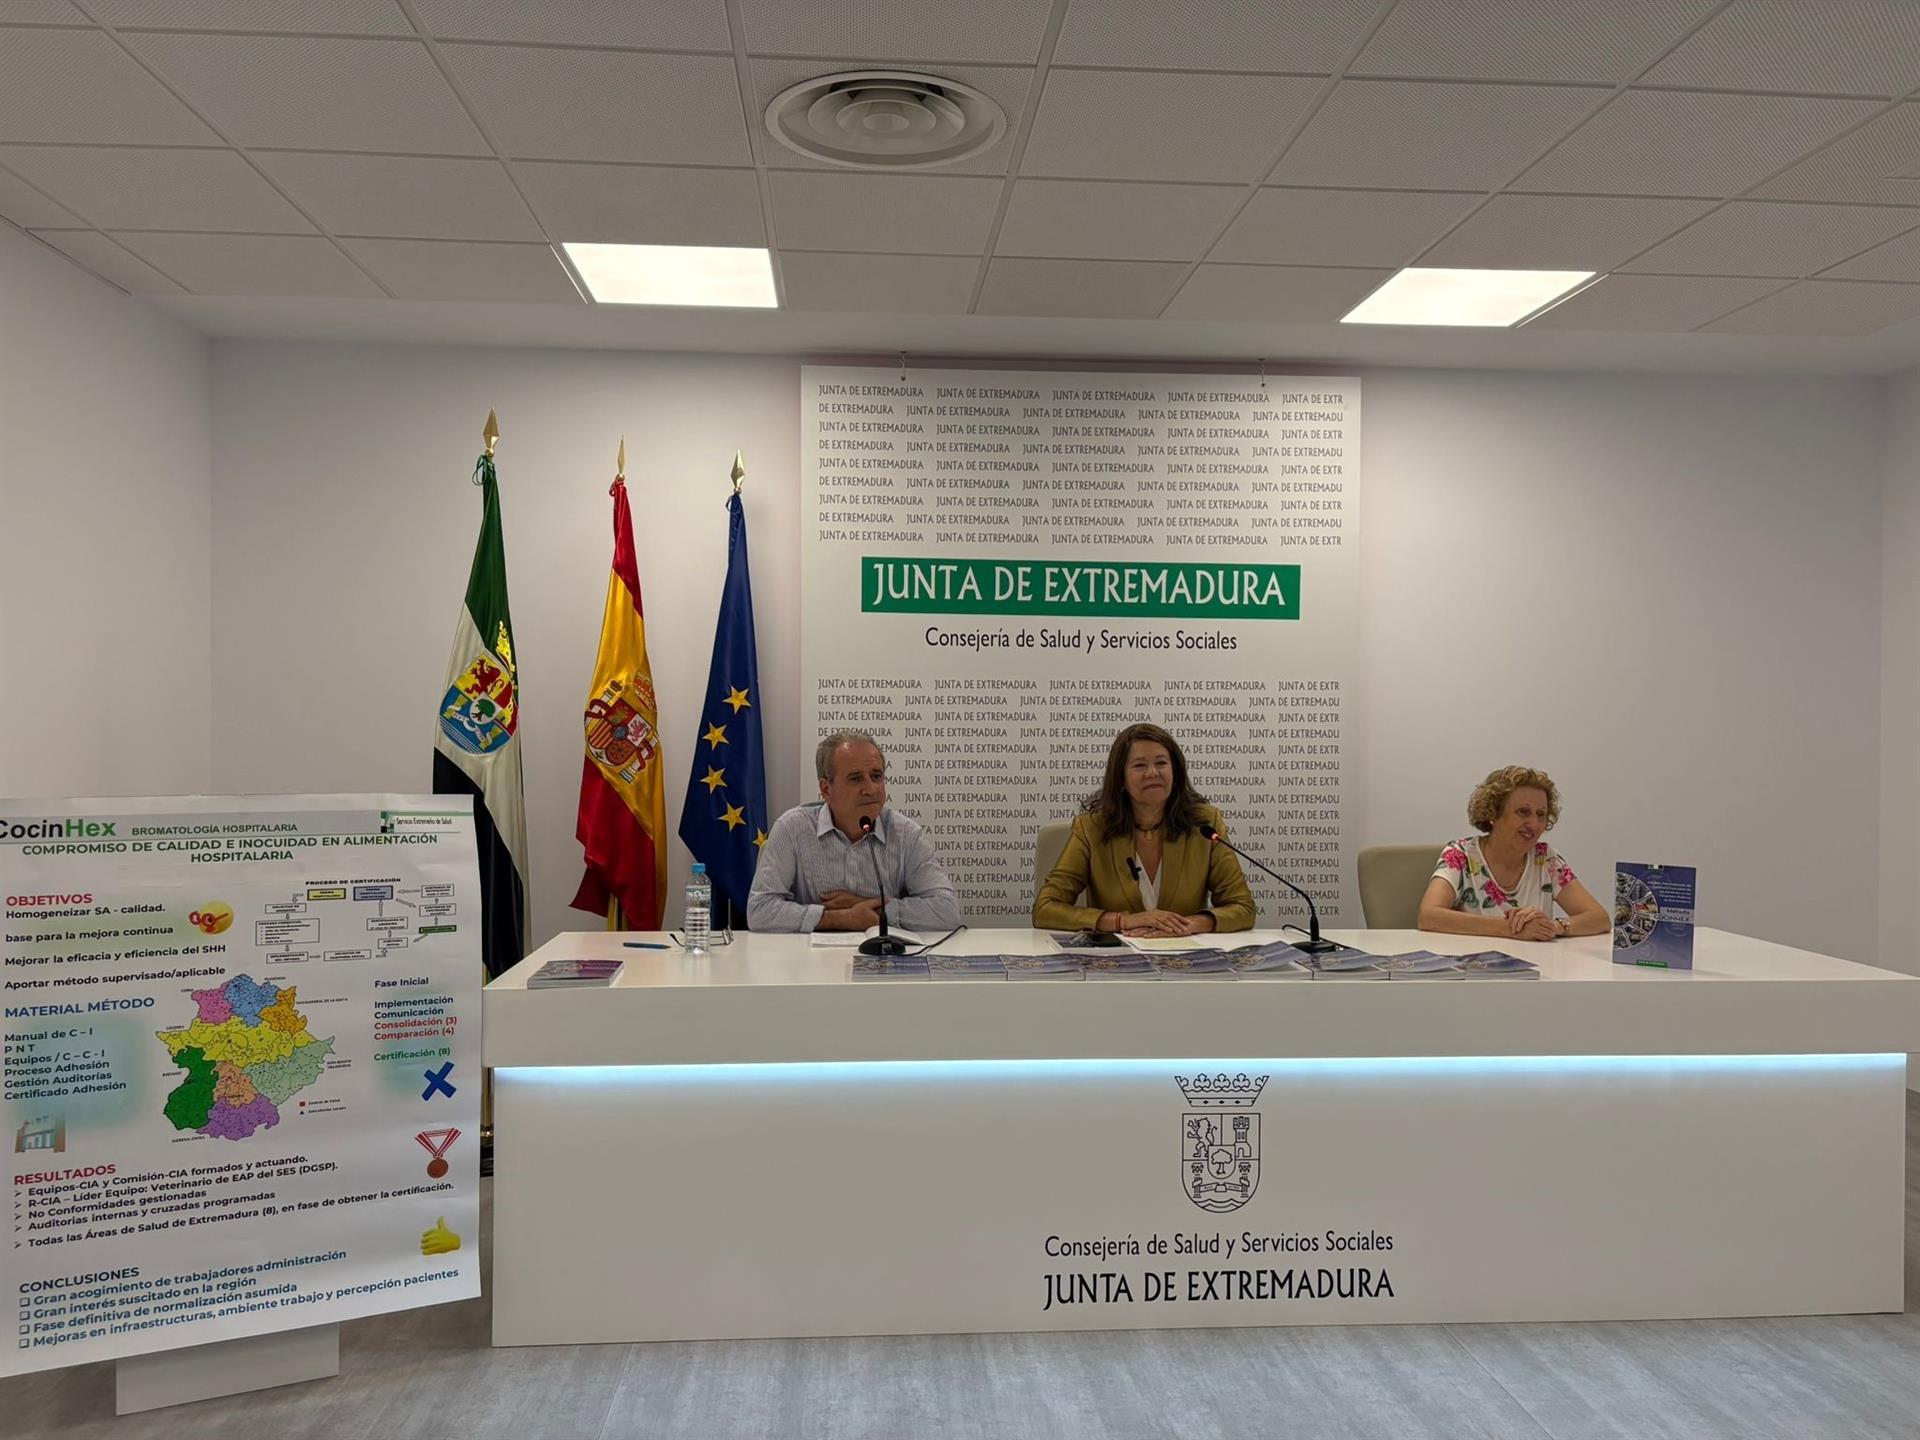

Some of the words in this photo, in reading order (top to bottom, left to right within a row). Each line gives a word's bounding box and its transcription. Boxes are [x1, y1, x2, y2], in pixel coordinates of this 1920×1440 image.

[819, 384, 847, 395] JUNTA
[849, 385, 859, 395] DE
[862, 384, 924, 397] EXTREMADURA
[1282, 391, 1310, 405] JUNTA
[1311, 392, 1323, 403] DE
[1324, 394, 1343, 403] EXTR
[873, 564, 982, 605] JUNTA
[995, 567, 1032, 601] DE
[1044, 569, 1287, 606] EXTREMADURA
[926, 627, 1009, 652] Consejería
[1016, 629, 1034, 647] de
[1041, 629, 1080, 648] Salud
[1087, 636, 1094, 653] y
[1101, 630, 1169, 648] Servicios
[1176, 630, 1236, 649] Sociales
[1164, 681, 1191, 691] JUNTA
[1194, 681, 1203, 690] DE
[1206, 681, 1266, 690] EXTREMADURA
[905, 760, 932, 770] JUNTA
[935, 760, 944, 769] DE
[947, 760, 1007, 769] EXTREMADURA
[132, 824, 220, 835] BROMATOLOGÍA
[223, 824, 297, 833] HOSPITALARIA
[23, 841, 127, 855] COMPROMISO
[133, 840, 152, 852] DE
[157, 840, 221, 851] CALIDAD
[226, 837, 236, 848] E
[238, 835, 317, 848] INOCUIDAD
[322, 837, 339, 846] EN
[343, 831, 438, 845] ALIMENTACIÓN
[191, 851, 293, 862] HOSPITALARIA
[6, 894, 92, 906] OBJETIVOS
[6, 908, 91, 919] Homogeneizar
[95, 907, 110, 915] SA
[121, 904, 165, 913] calidad.
[6, 934, 32, 942] base
[36, 934, 62, 943] para
[79, 929, 119, 939] mejora
[123, 926, 173, 936] continua
[5, 956, 50, 967] Mejorar
[54, 955, 63, 963] la
[67, 952, 111, 962] eficacia
[124, 947, 178, 958] eficiencia
[182, 946, 199, 954] del
[202, 945, 225, 953] SHH
[5, 981, 49, 990] Aportar
[54, 976, 99, 986] método
[102, 967, 225, 983] supervisado/aplicable
[400, 977, 428, 986] Inicial
[5, 1004, 83, 1018] MATERIAL
[88, 998, 154, 1012] MÉTODO
[375, 996, 453, 1009] Implementación
[375, 1007, 443, 1019] Comunicación
[375, 1018, 442, 1030] Consolidación
[446, 1016, 457, 1028] (3)
[374, 1029, 439, 1040] Comparación
[442, 1027, 454, 1036] (4)
[374, 1049, 435, 1060] Certificación
[439, 1047, 450, 1057] (8)
[5, 1067, 51, 1076] Proceso
[55, 1061, 109, 1072] Adhesión
[5, 1078, 49, 1088] Gestión
[5, 1088, 69, 1100] Certificado
[72, 1082, 126, 1094] Adhesión
[14, 1164, 116, 1185] RESULTADOS
[29, 1181, 99, 1196] Equipos-CIA
[113, 1170, 188, 1185] Comisión-CIA
[191, 1164, 243, 1176] formados
[256, 1156, 308, 1168] actuando.
[29, 1197, 61, 1207] R-CIA
[74, 1192, 102, 1202] Líder
[106, 1186, 147, 1202] Equipo:
[151, 1178, 212, 1191] Veterinario
[215, 1176, 229, 1184] de
[232, 1173, 254, 1182] EAP
[257, 1170, 273, 1178] del
[277, 1167, 296, 1176] SES
[28, 1237, 63, 1247] Todas
[67, 1234, 82, 1242] las
[85, 1229, 117, 1239] Áreas
[121, 1226, 135, 1234] de
[138, 1221, 169, 1232] Salud
[172, 1219, 186, 1227] de
[189, 1210, 259, 1225] Extremadura
[263, 1206, 278, 1216] (8),
[298, 1202, 319, 1210] fase
[338, 1193, 377, 1204] obtener
[392, 1183, 454, 1197] certificación.
[29, 1211, 45, 1219] No
[48, 1199, 135, 1216] Conformidades
[139, 1191, 206, 1206] gestionadas
[92, 1210, 138, 1222] internas
[151, 1202, 200, 1214] cruzadas
[204, 1193, 275, 1209] programadas
[1045, 1234, 1139, 1261] Consejería
[1147, 1234, 1167, 1254] de
[1175, 1233, 1219, 1254] Salud
[1226, 1239, 1235, 1259] y
[1242, 1232, 1319, 1252] Servicios
[1326, 1230, 1393, 1251] Sociales
[20, 1267, 139, 1293] CONCLUSIONES
[34, 1294, 66, 1305] Gran
[70, 1282, 152, 1300] acogimiento
[155, 1277, 171, 1287] de
[174, 1266, 254, 1284] trabajadores
[256, 1251, 346, 1272] administración
[34, 1307, 66, 1318] Gran
[70, 1298, 116, 1313] interés
[119, 1289, 181, 1305] suscitado
[203, 1284, 213, 1293] la
[217, 1278, 256, 1294] región
[1043, 1273, 1133, 1310] JUNTA
[1145, 1272, 1177, 1301] DE
[1188, 1269, 1394, 1301] EXTREMADURA
[34, 1321, 65, 1332] Fase
[68, 1311, 130, 1327] definitiva
[134, 1307, 150, 1316] de
[154, 1292, 242, 1313] normalización
[245, 1283, 297, 1299] asumida
[34, 1331, 87, 1346] Mejoras
[90, 1328, 106, 1337] en
[110, 1311, 215, 1334] infraestructuras,
[218, 1301, 277, 1316] ambiente
[280, 1292, 324, 1306] trabajo
[336, 1279, 401, 1299] percepción
[404, 1270, 459, 1287] pacientes
